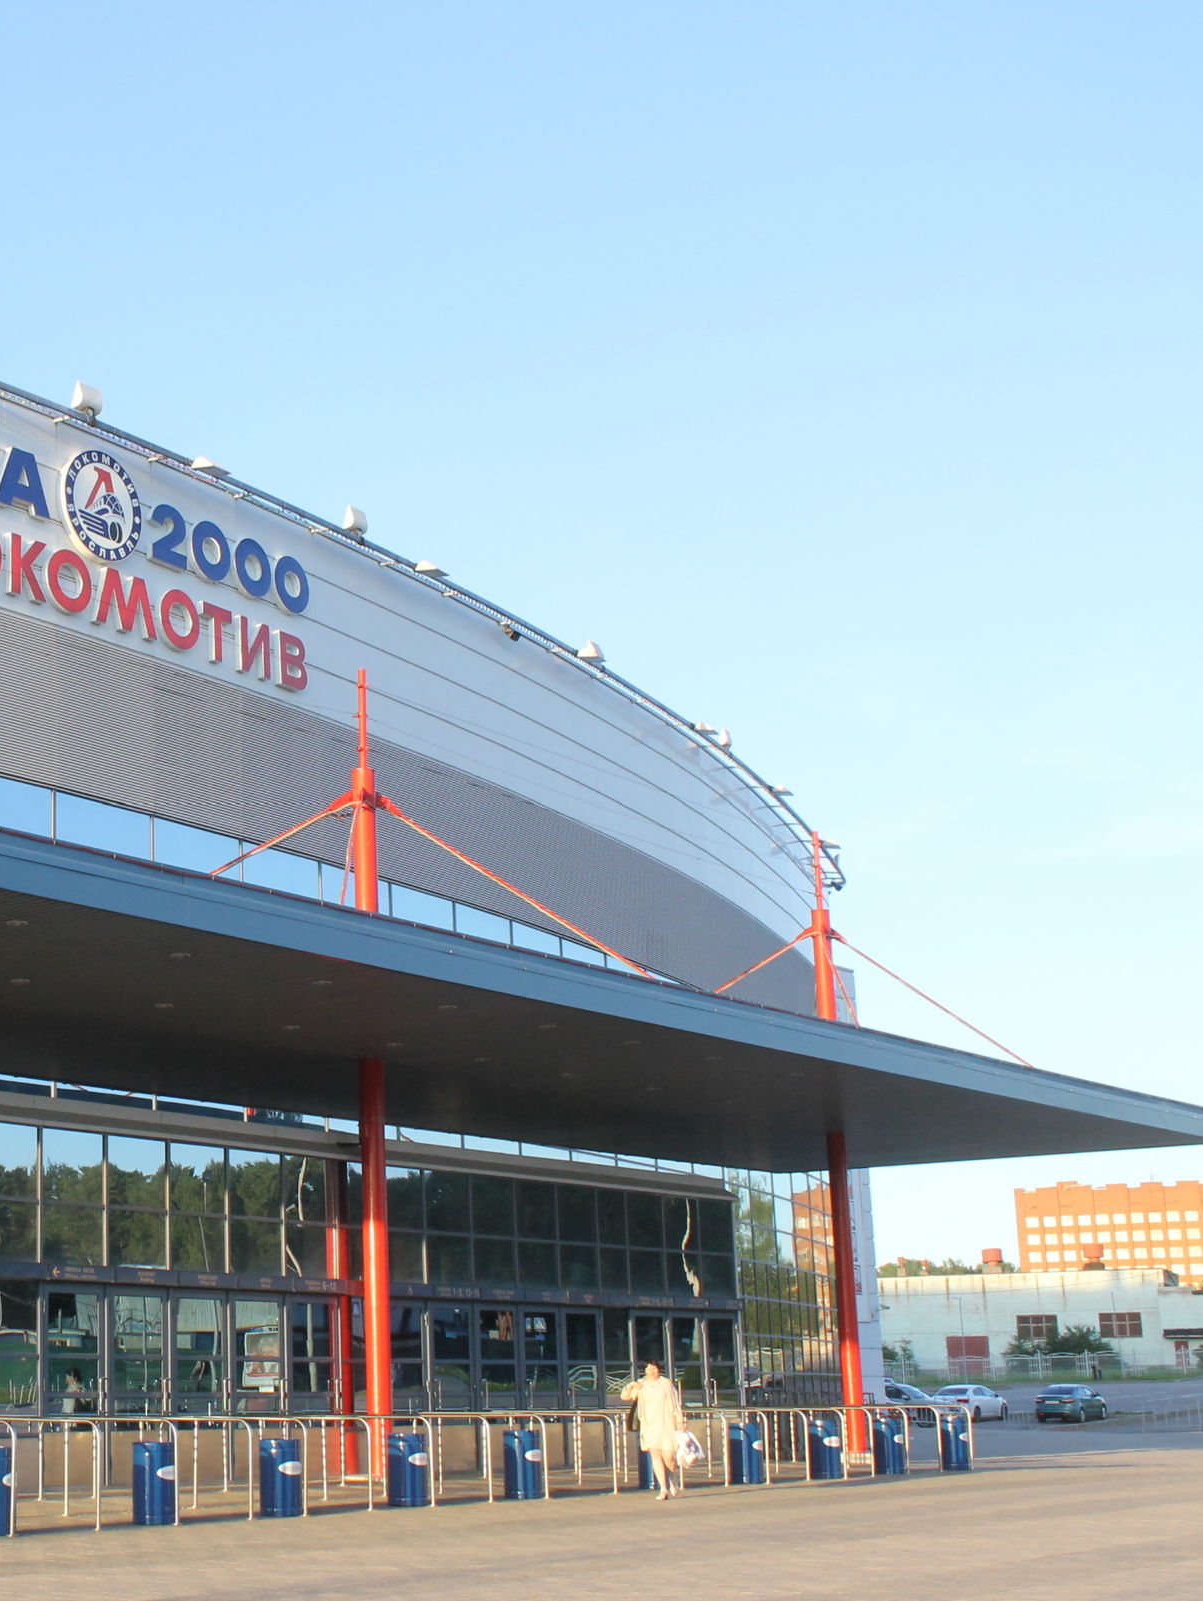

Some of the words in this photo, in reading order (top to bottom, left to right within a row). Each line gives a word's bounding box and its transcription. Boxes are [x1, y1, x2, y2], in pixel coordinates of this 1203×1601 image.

[68, 451, 139, 507] ЛОКОМОТИВ
[66, 503, 139, 560] ЯРОСЛАВЛЬ
[148, 503, 310, 615] 2000
